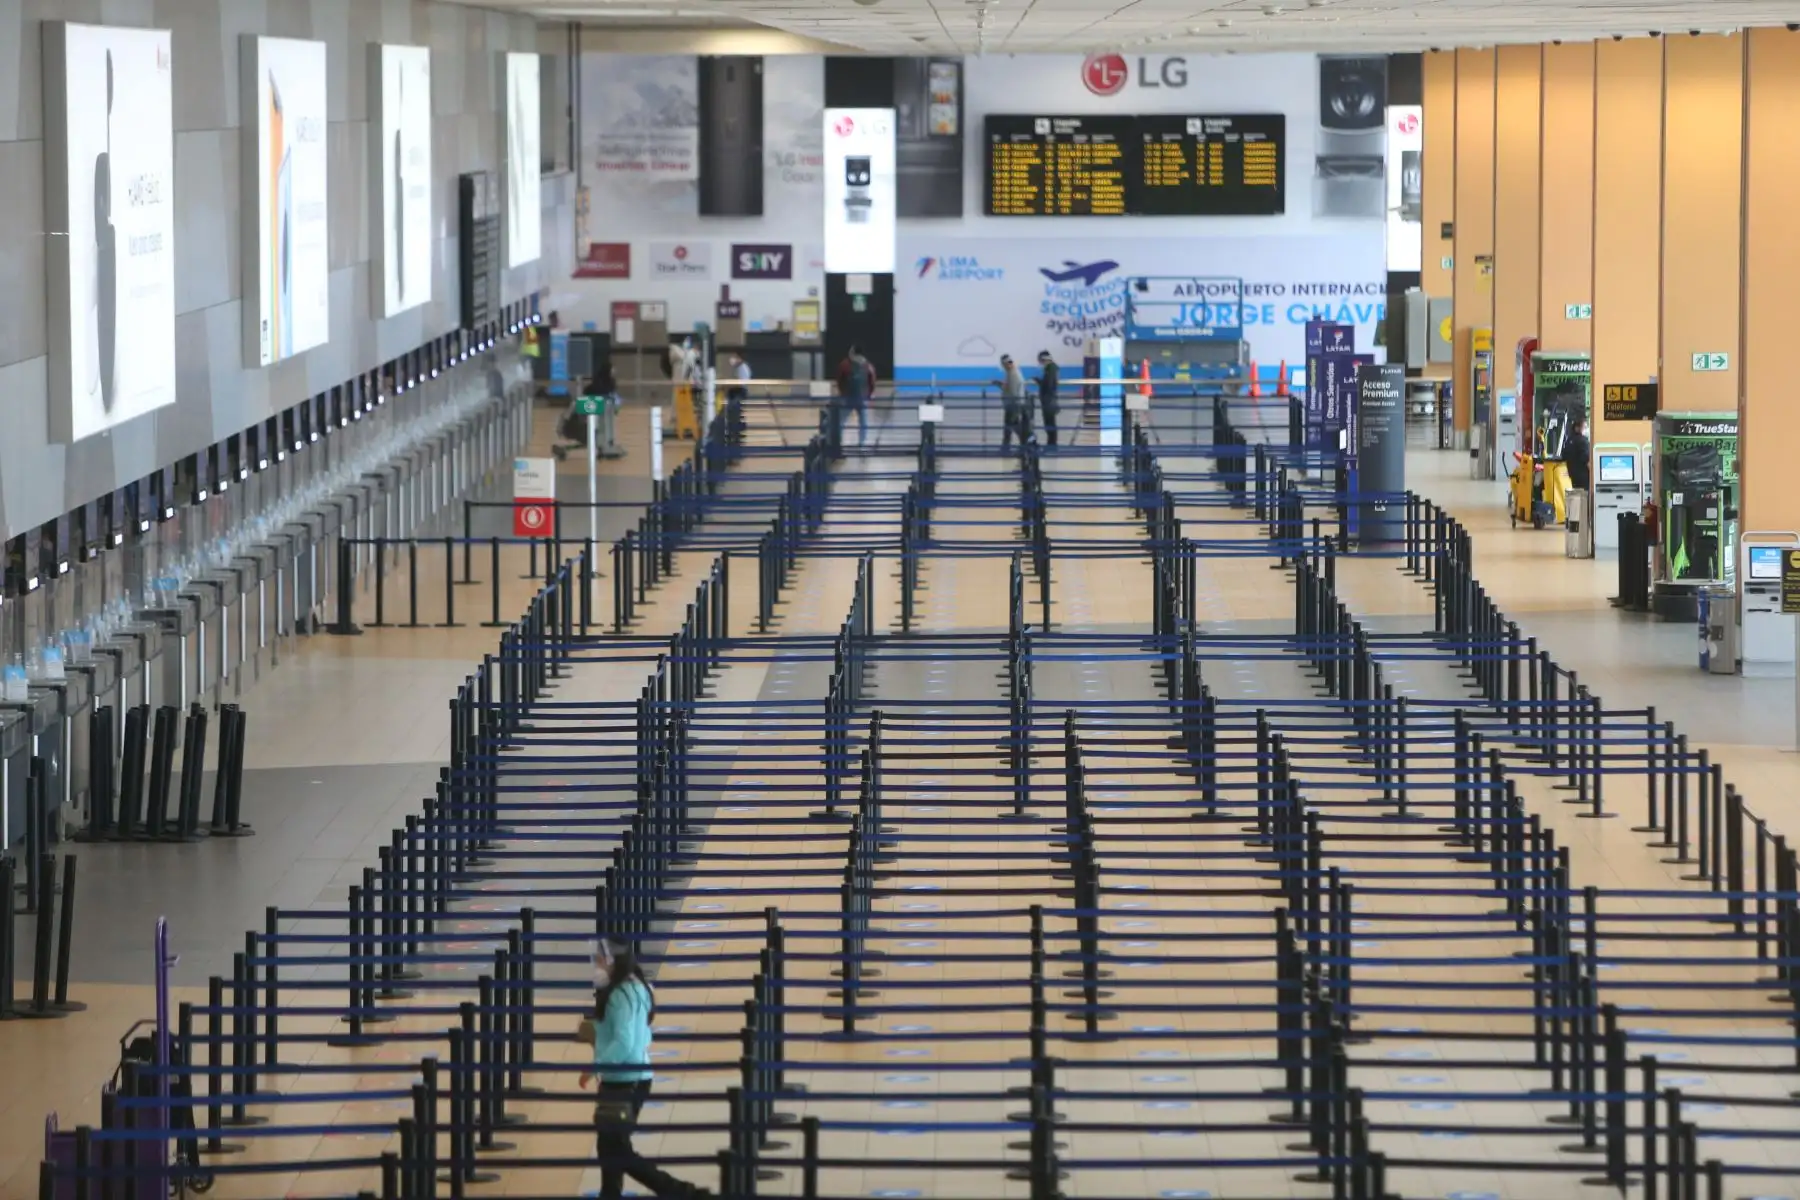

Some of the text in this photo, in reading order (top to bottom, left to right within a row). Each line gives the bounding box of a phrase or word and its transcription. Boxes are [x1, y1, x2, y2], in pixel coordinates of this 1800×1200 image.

[1138, 57, 1188, 88] LG
[940, 256, 978, 267] LIMA
[939, 268, 1004, 281] AIRPORT
[1173, 283, 1286, 296] AEROPUERTO
[1172, 303, 1276, 325] JORGE
[1362, 380, 1391, 389] Acceso
[1362, 388, 1399, 398] Premium
[1326, 398, 1335, 419] Otros
